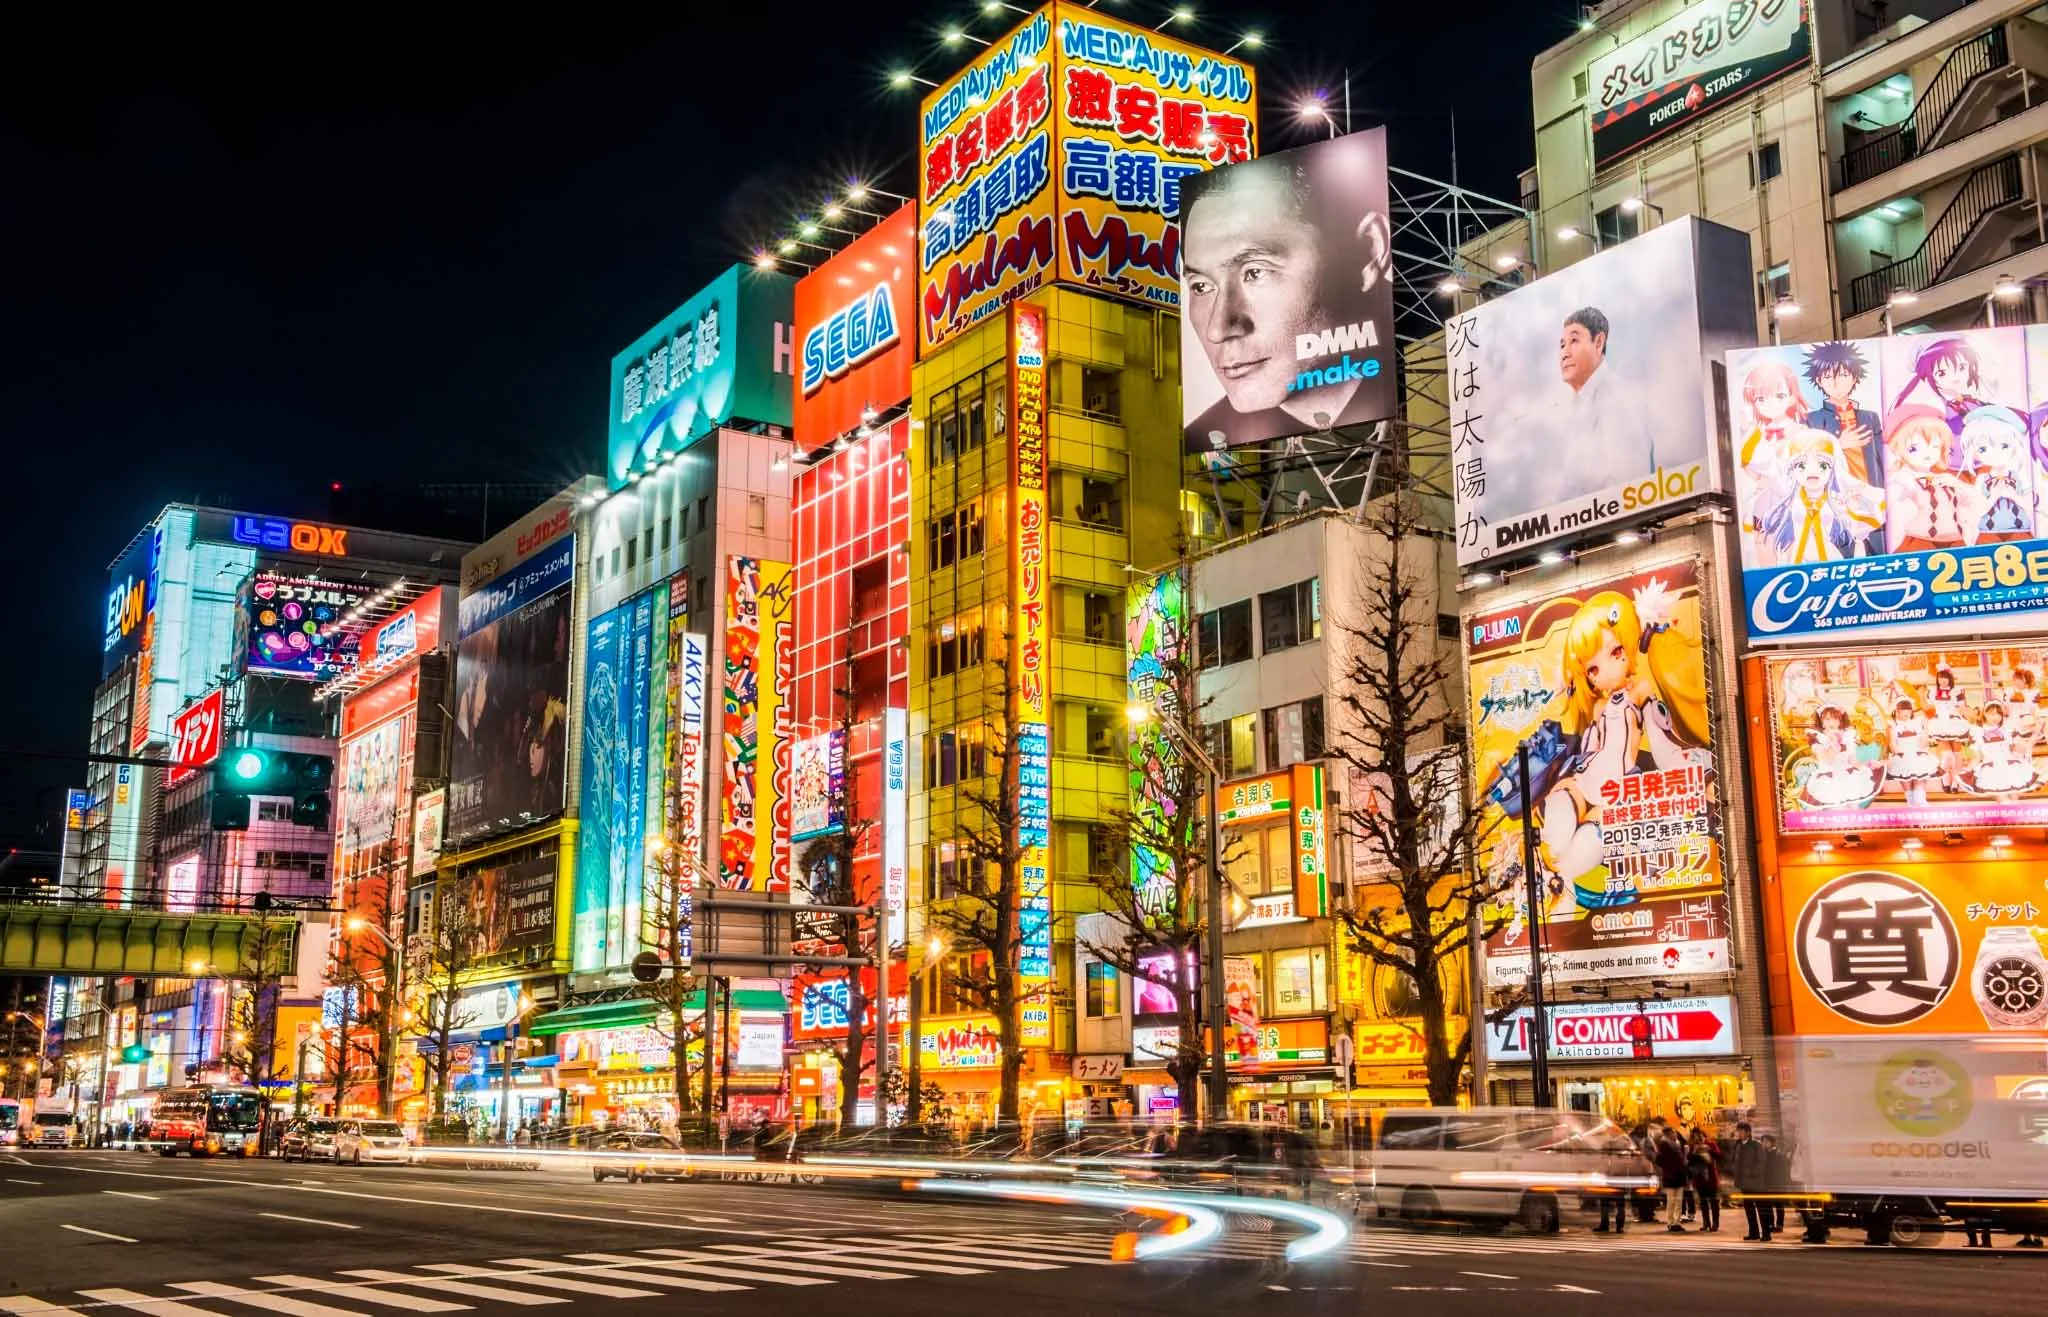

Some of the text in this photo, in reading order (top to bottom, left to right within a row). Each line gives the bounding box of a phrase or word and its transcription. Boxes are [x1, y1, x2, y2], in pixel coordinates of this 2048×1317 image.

[924, 14, 1049, 143] MEDIAリサイクル
[1063, 21, 1250, 103] MEDIAリサイクル
[1066, 68, 1251, 165] 激安販売
[1649, 97, 1686, 127] POKER
[925, 67, 1048, 203] 激安販売
[924, 132, 1048, 271] 高額買取
[924, 215, 1054, 343] Mulan
[1085, 271, 1145, 295] ムーラン
[972, 297, 1001, 321] AKIBA
[802, 281, 898, 395] SEGA
[1295, 320, 1378, 360] DMM
[1019, 370, 1041, 384] DVD
[1018, 398, 1042, 411] ゲーム
[1021, 411, 1039, 423] CD
[1018, 436, 1042, 449] アニメ
[1449, 314, 1491, 559] 次は太陽か。
[1622, 465, 1701, 511] solar
[255, 573, 287, 584] ADULT
[1474, 616, 1520, 645] PLUM
[1813, 608, 1927, 629] 365 DAYS ANNIVERSARY
[376, 608, 417, 671] SEGA
[685, 637, 703, 710] AKKY
[681, 730, 702, 829] Tax-free
[889, 739, 904, 791] SEGA
[1233, 781, 1273, 806] 吉野家
[1600, 766, 1704, 805] 今月発売!!
[1300, 808, 1315, 874] 吉野家
[1603, 819, 1707, 845] 2019.2 発売予定
[1592, 909, 1654, 932] amiami
[1966, 901, 2039, 920] チケット
[1563, 958, 1588, 971] Anime
[1590, 957, 1615, 970] goods
[1617, 955, 1633, 967] and
[1635, 954, 1658, 965] more
[1815, 892, 1948, 1007] 質
[51, 984, 66, 1021] AKIBA
[802, 978, 870, 1031] SEG
[1023, 1011, 1048, 1022] AKIBA
[1079, 1059, 1118, 1077] ラーメン
[1557, 1046, 1624, 1057] Akihabara
